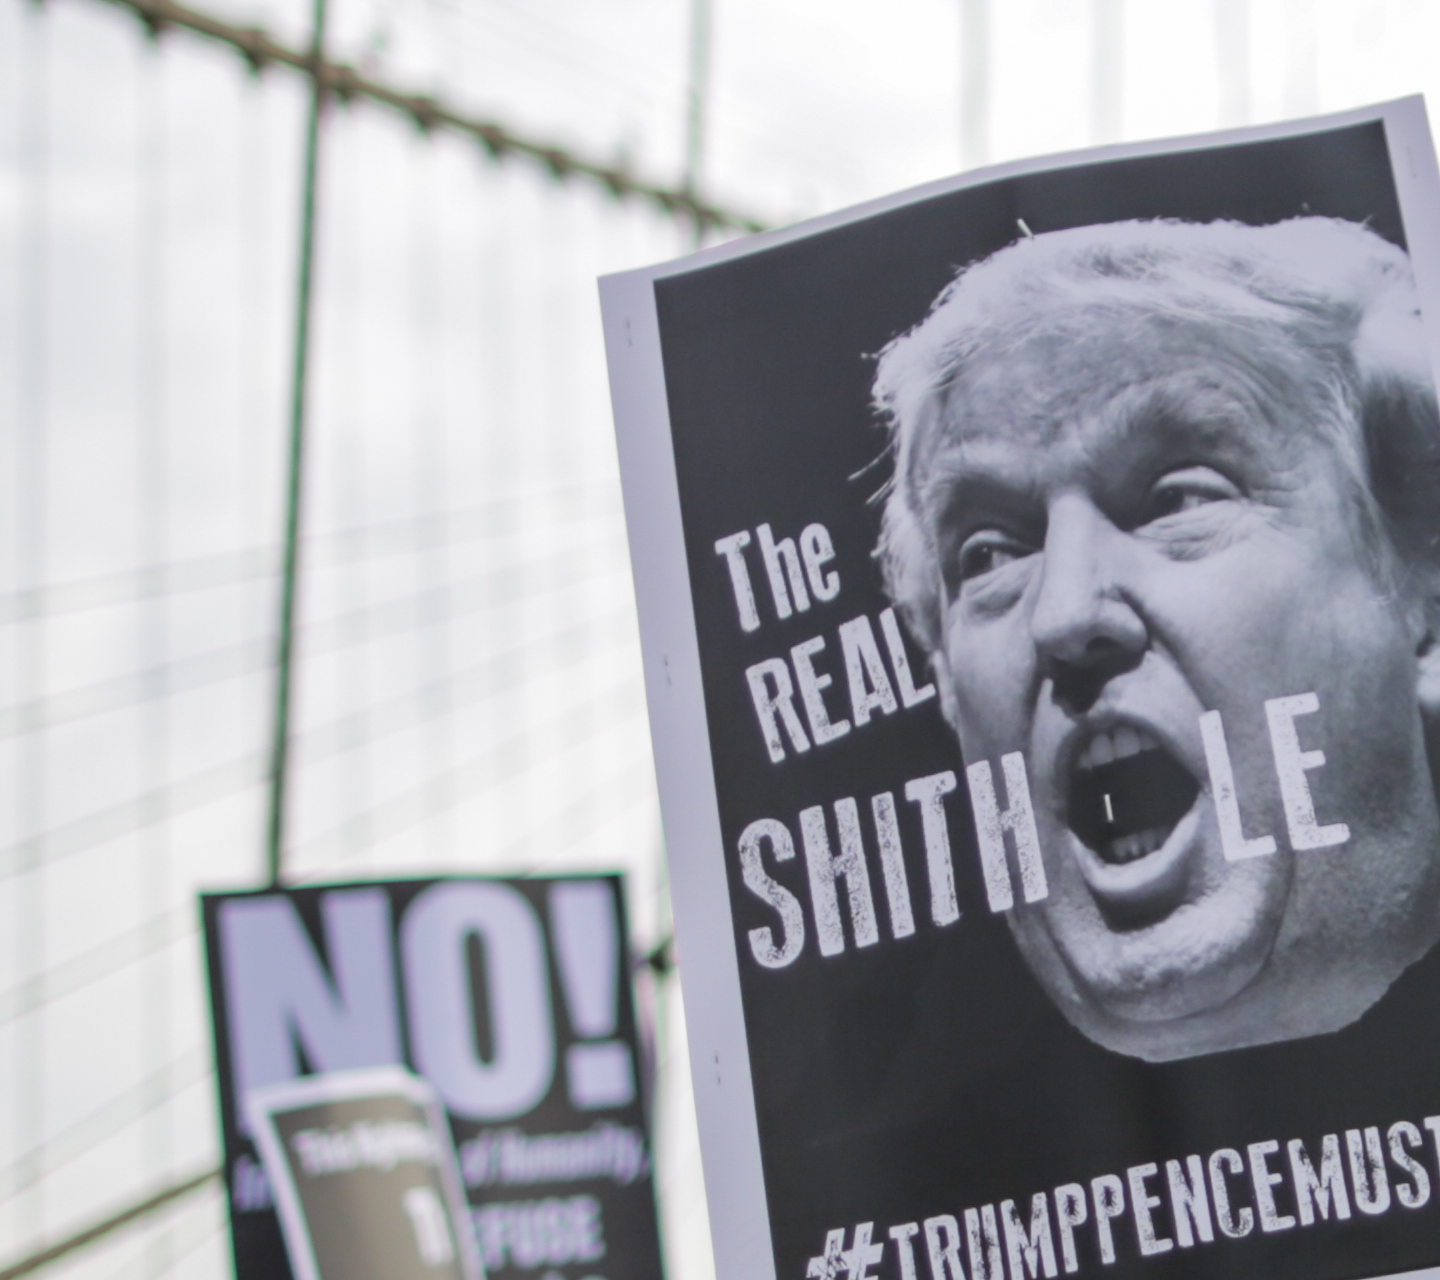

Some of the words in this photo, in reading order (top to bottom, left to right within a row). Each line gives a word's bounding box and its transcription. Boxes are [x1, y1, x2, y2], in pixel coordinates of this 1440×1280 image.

[716, 523, 841, 631] The
[745, 608, 935, 763] REAL
[217, 877, 636, 1132] NO!
